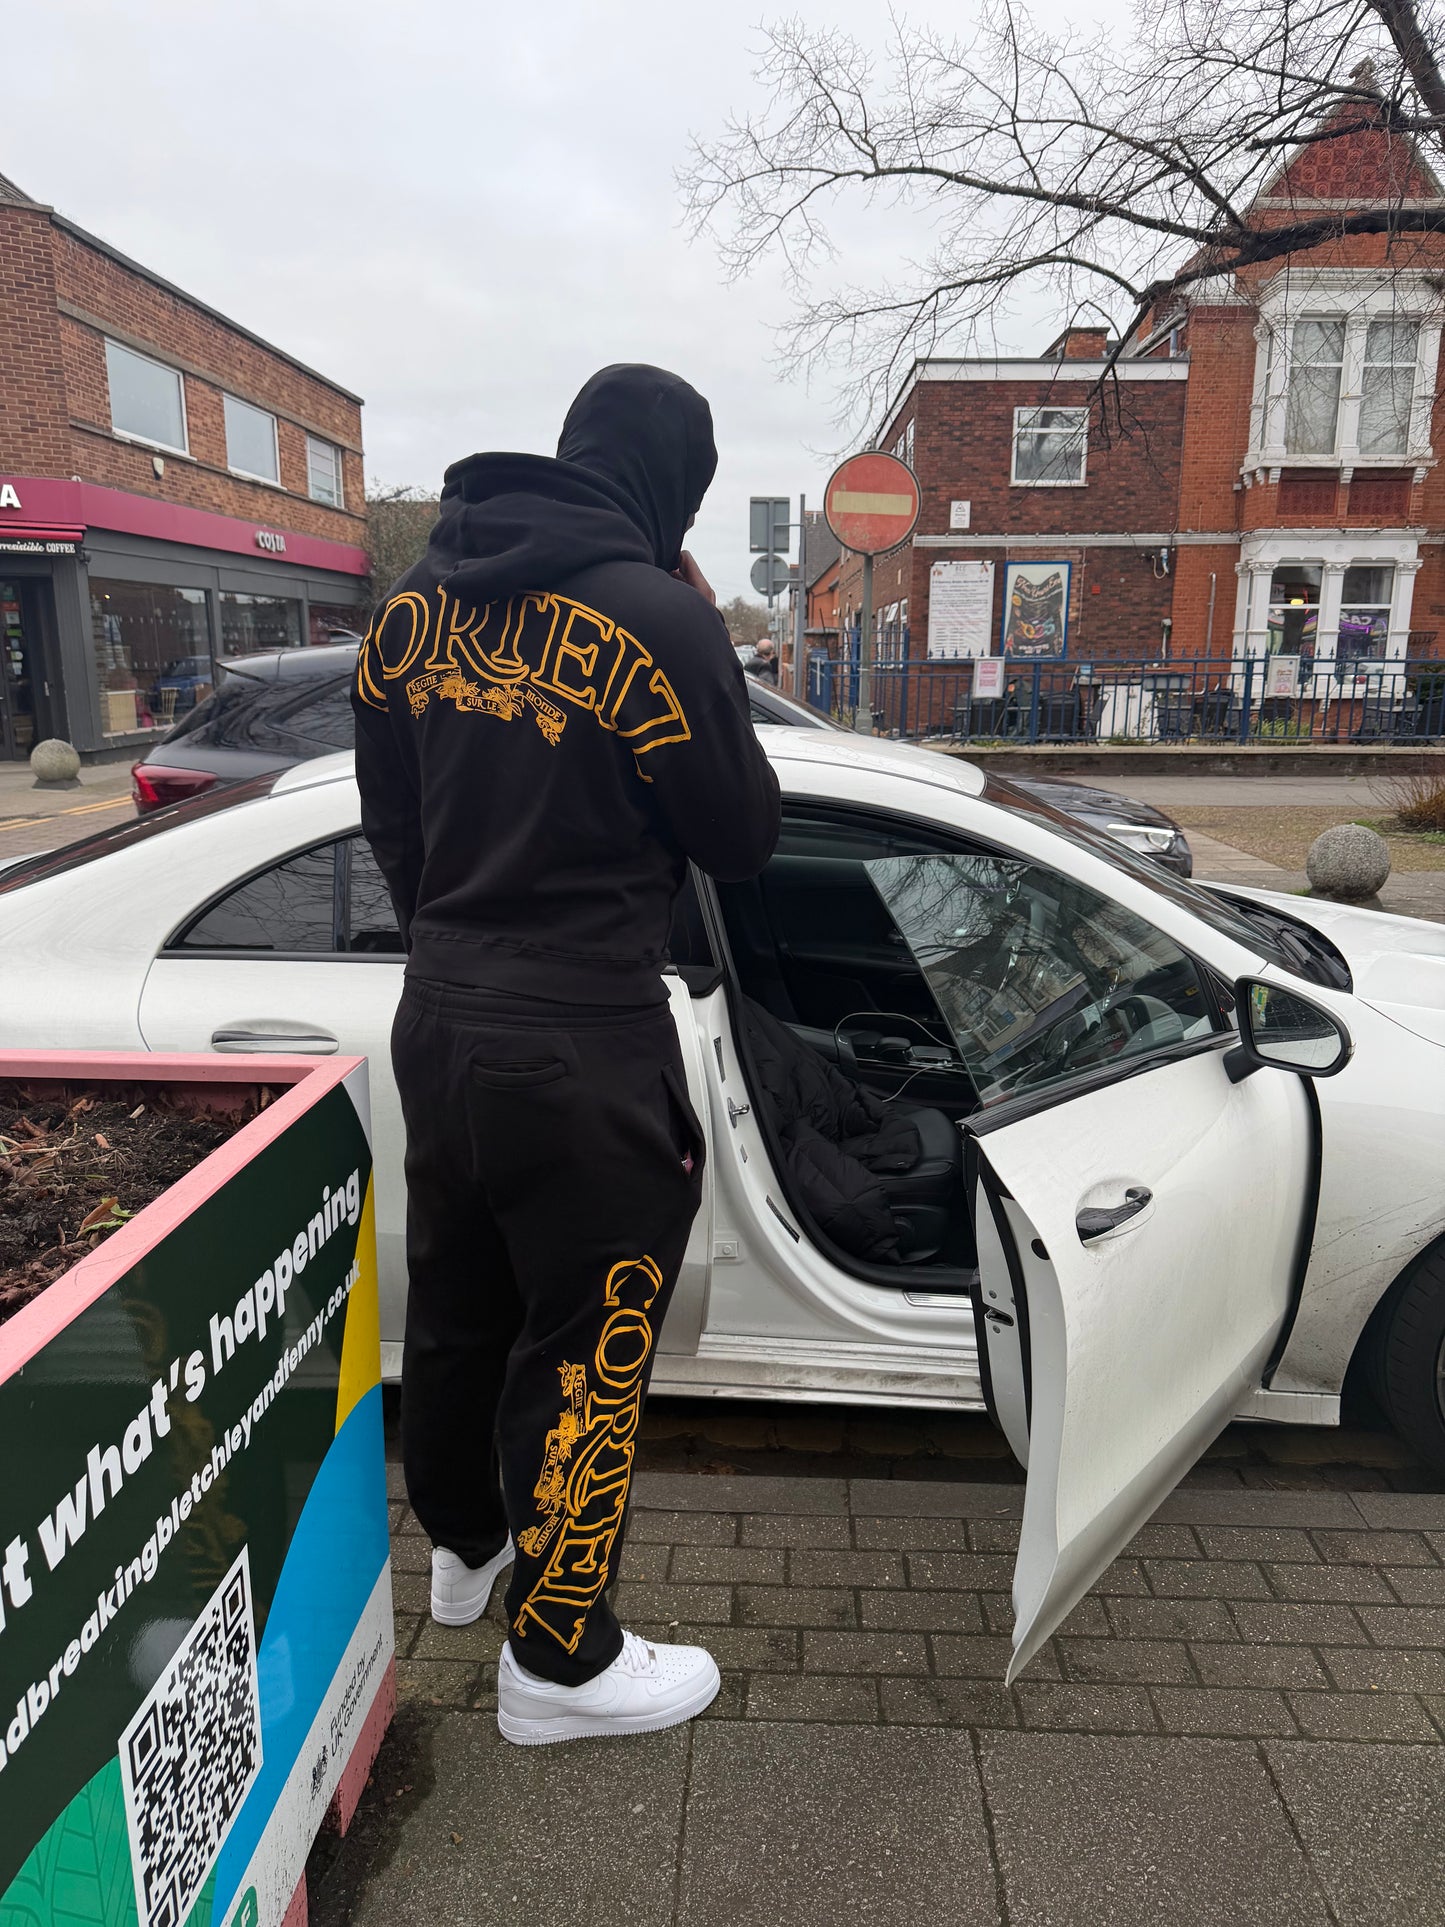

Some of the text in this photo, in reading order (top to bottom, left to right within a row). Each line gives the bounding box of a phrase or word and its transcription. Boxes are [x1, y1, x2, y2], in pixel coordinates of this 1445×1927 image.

[46, 543, 76, 553] COFFEE
[256, 530, 287, 552] COSTA
[467, 697, 486, 708] SUR
[486, 702, 497, 711] LE
[525, 688, 562, 720] MONDE
[38, 1349, 206, 1572] what's
[209, 1168, 360, 1376] happening
[547, 1444, 558, 1466] SUR
[543, 1468, 553, 1484] LE
[534, 1515, 560, 1553] MONDE
[330, 1651, 367, 1738] Funded by
[331, 1633, 383, 1757] UK Government
